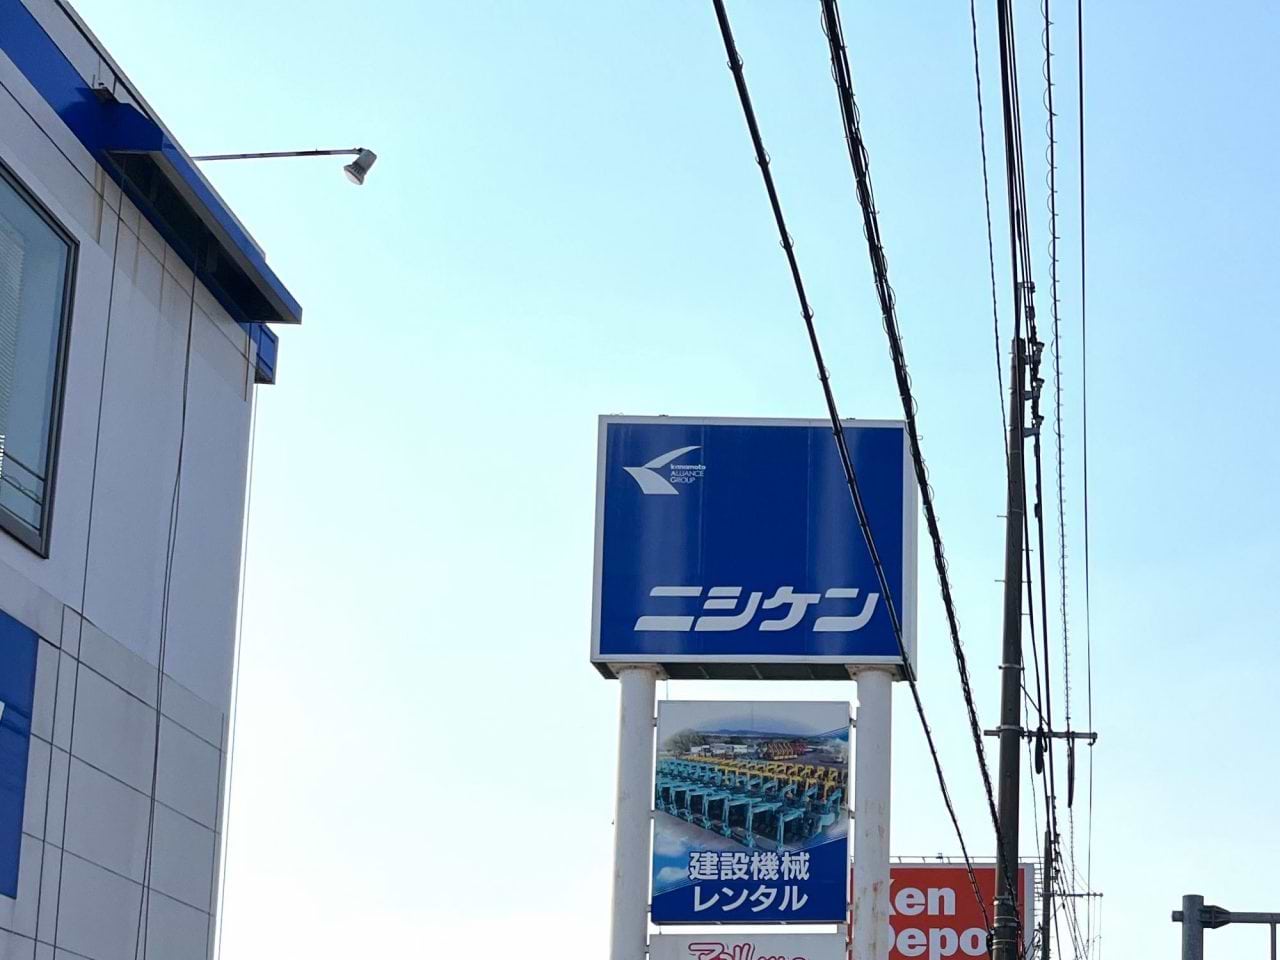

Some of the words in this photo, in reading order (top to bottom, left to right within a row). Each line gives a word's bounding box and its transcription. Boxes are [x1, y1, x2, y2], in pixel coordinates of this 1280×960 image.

[634, 585, 880, 632] ニシケン
[689, 852, 810, 881] 建設機械
[694, 884, 809, 912] レンタル
